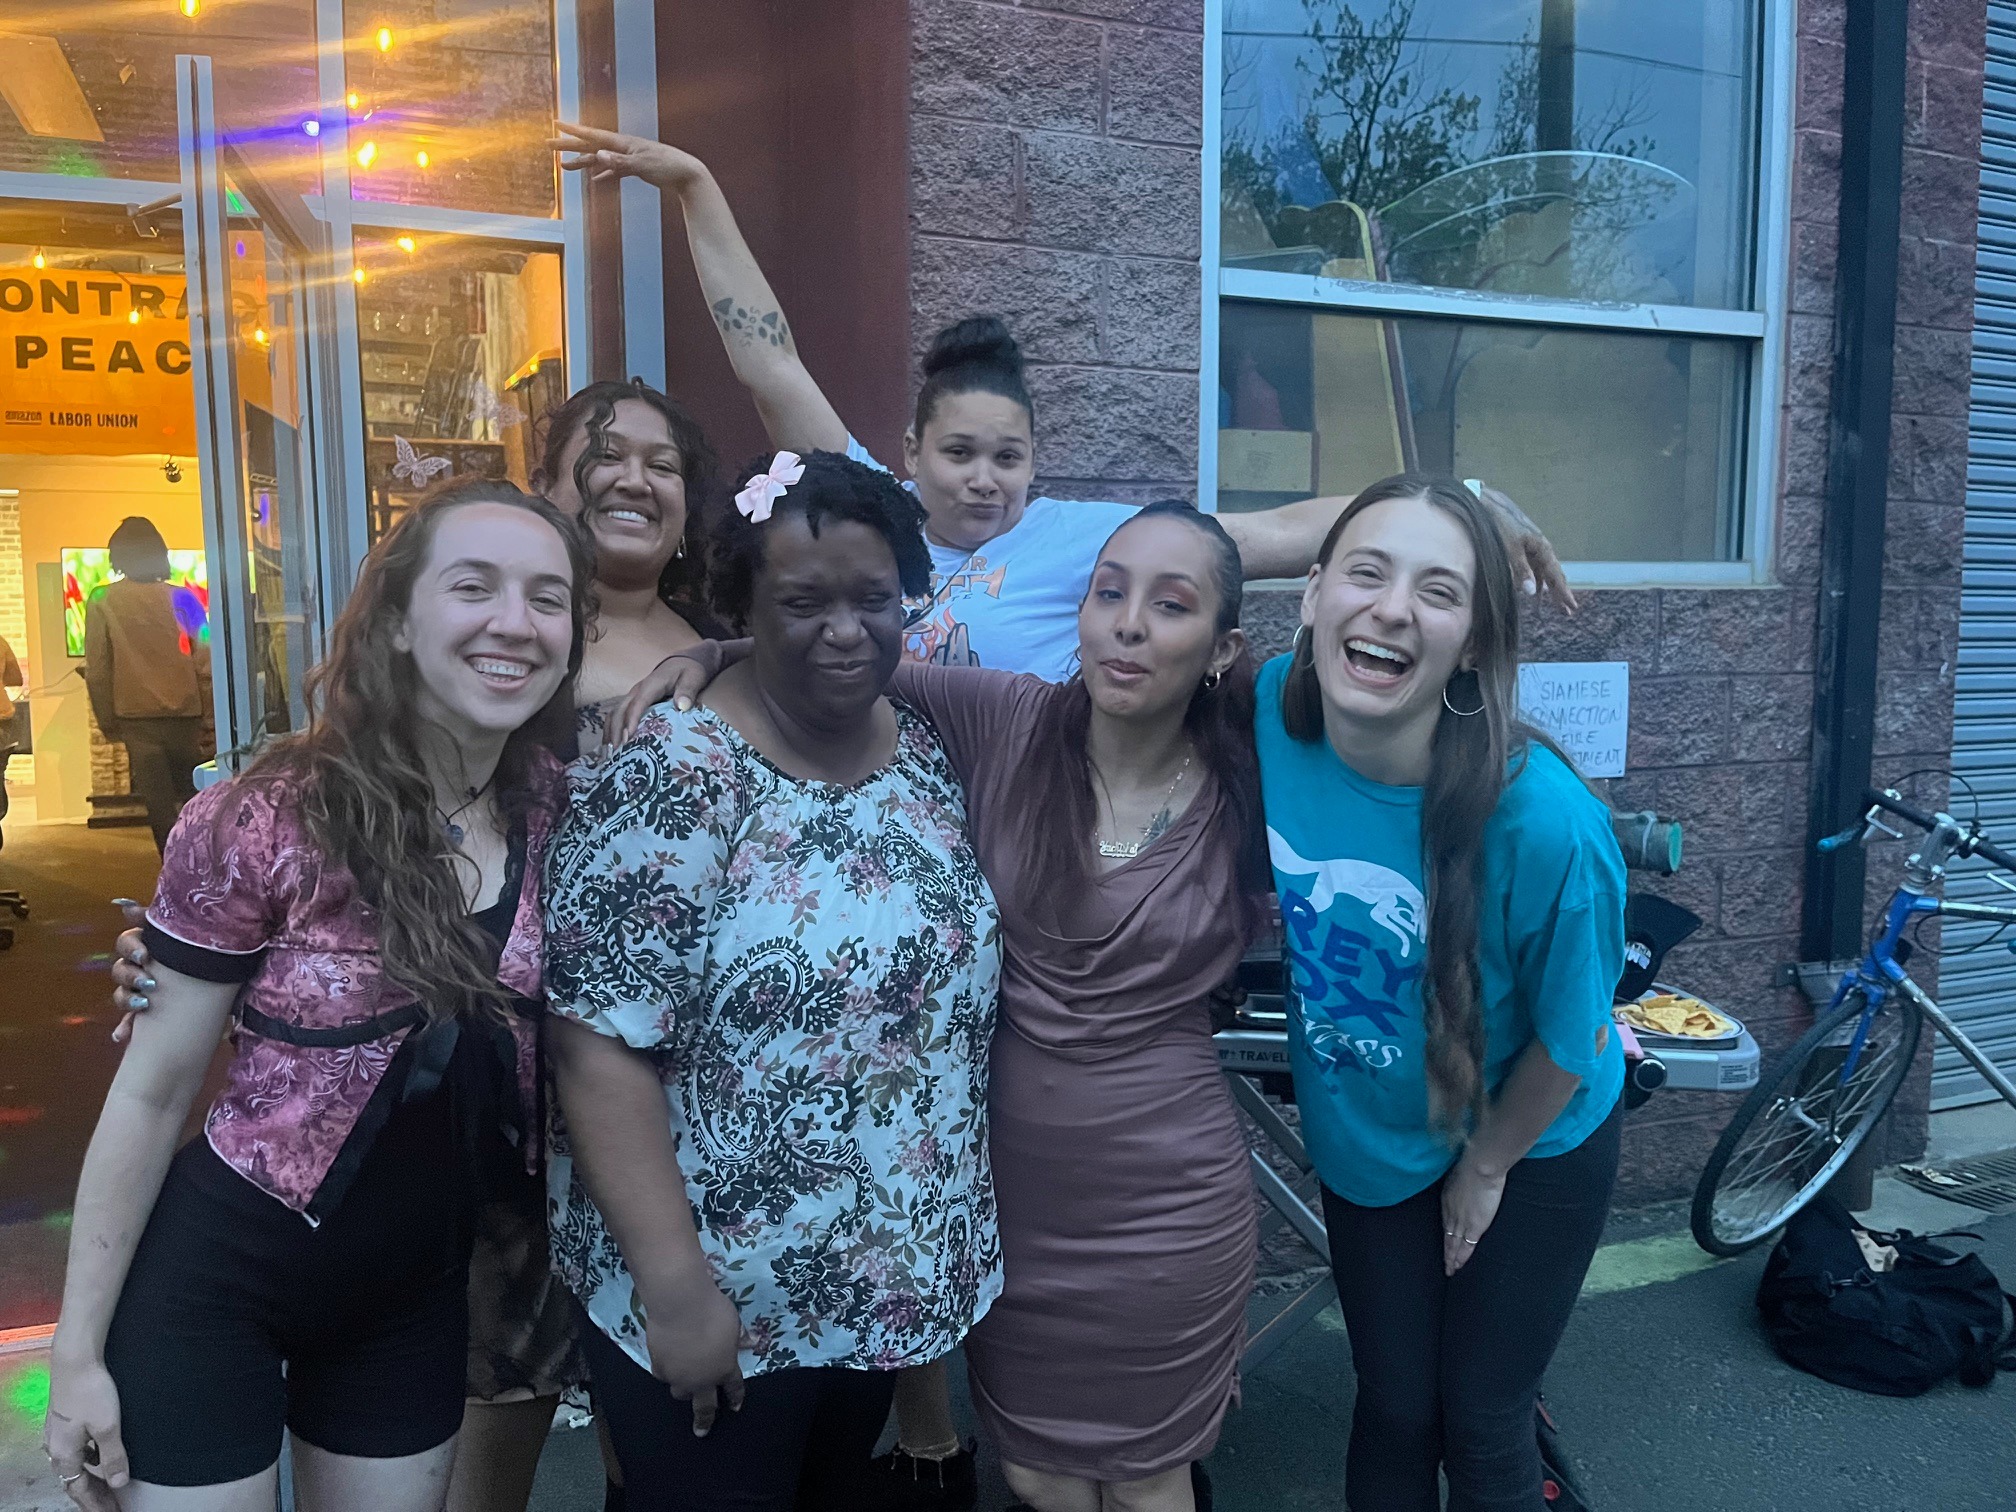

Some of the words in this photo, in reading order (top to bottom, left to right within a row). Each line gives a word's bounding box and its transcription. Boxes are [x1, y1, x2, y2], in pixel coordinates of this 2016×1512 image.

[50, 412, 92, 427] LABOR
[97, 413, 138, 428] UNION
[1540, 680, 1612, 701] SIAMESE
[1561, 730, 1600, 747] FIRE
